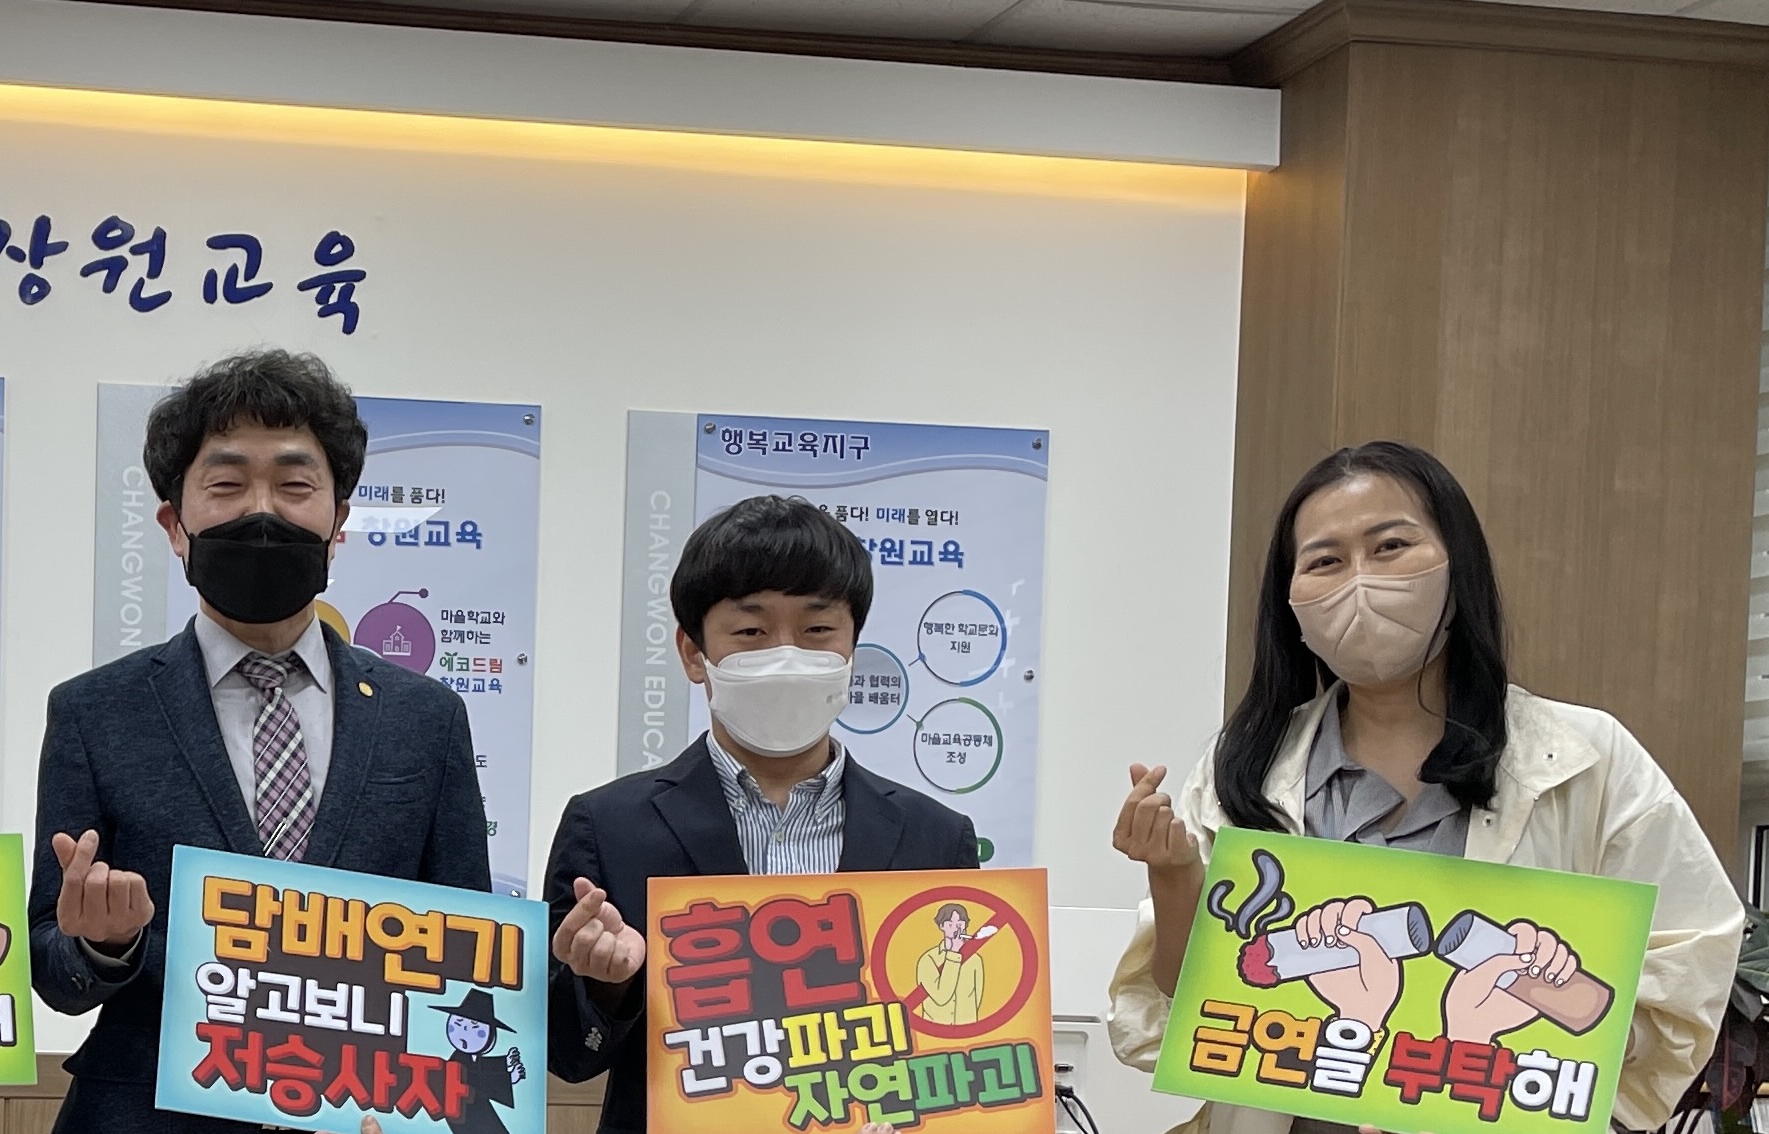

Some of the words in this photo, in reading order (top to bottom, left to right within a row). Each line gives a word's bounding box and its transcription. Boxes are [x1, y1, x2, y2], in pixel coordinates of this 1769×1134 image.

[721, 428, 871, 461] 행복교육지구
[358, 485, 405, 504] 미래를
[410, 487, 446, 504] 품다!
[835, 504, 869, 522] 품다!
[876, 507, 921, 526] 미래를
[925, 509, 959, 526] 열다!
[119, 465, 144, 647] CHANGWON
[362, 515, 482, 550] 창원교육
[645, 489, 671, 666] CHANGWON
[440, 609, 506, 626] 마을학교와
[440, 629, 491, 645] 함께하는
[439, 652, 503, 674] 에코드림
[950, 641, 971, 654] 지원
[946, 751, 967, 765] 조성
[203, 875, 524, 994] 담배연기
[660, 893, 868, 1028] 흡연
[195, 961, 406, 1037] 알고보니
[191, 1022, 470, 1123] 저승사자
[664, 1001, 913, 1098] 건강파괴
[1190, 999, 1377, 1097] 금연을
[1383, 1030, 1599, 1122] 부탁해
[782, 1043, 1043, 1131] 자연파괴
